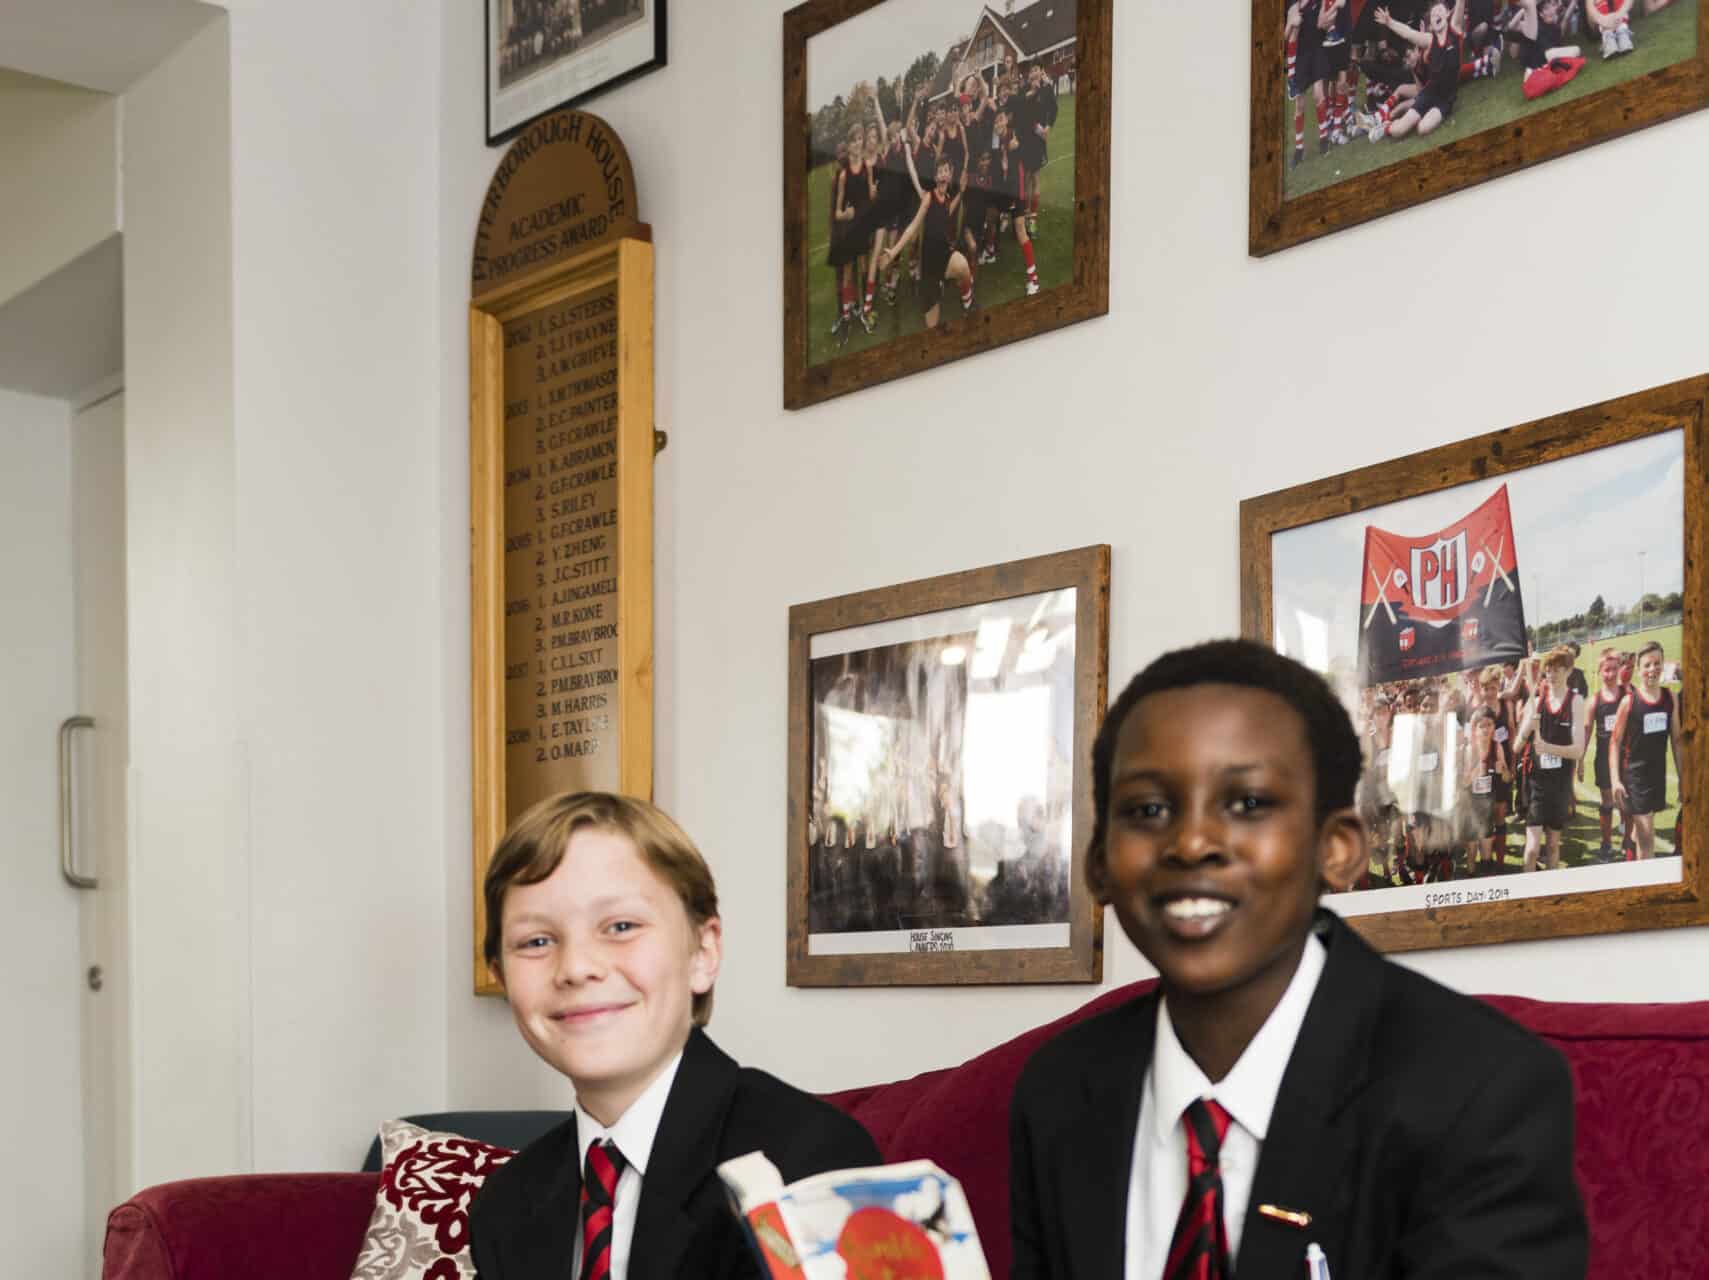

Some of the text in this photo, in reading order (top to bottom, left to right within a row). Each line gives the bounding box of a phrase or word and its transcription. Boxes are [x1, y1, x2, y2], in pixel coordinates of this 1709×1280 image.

[586, 126, 625, 224] HOUSE
[488, 214, 609, 276] PROGRESS AWARD
[511, 192, 586, 242] ACADEMIC
[1420, 539, 1460, 607] PH
[551, 693, 609, 716] M.HARRIS
[1425, 891, 1462, 906] SPORTS
[1466, 890, 1484, 903] DAY
